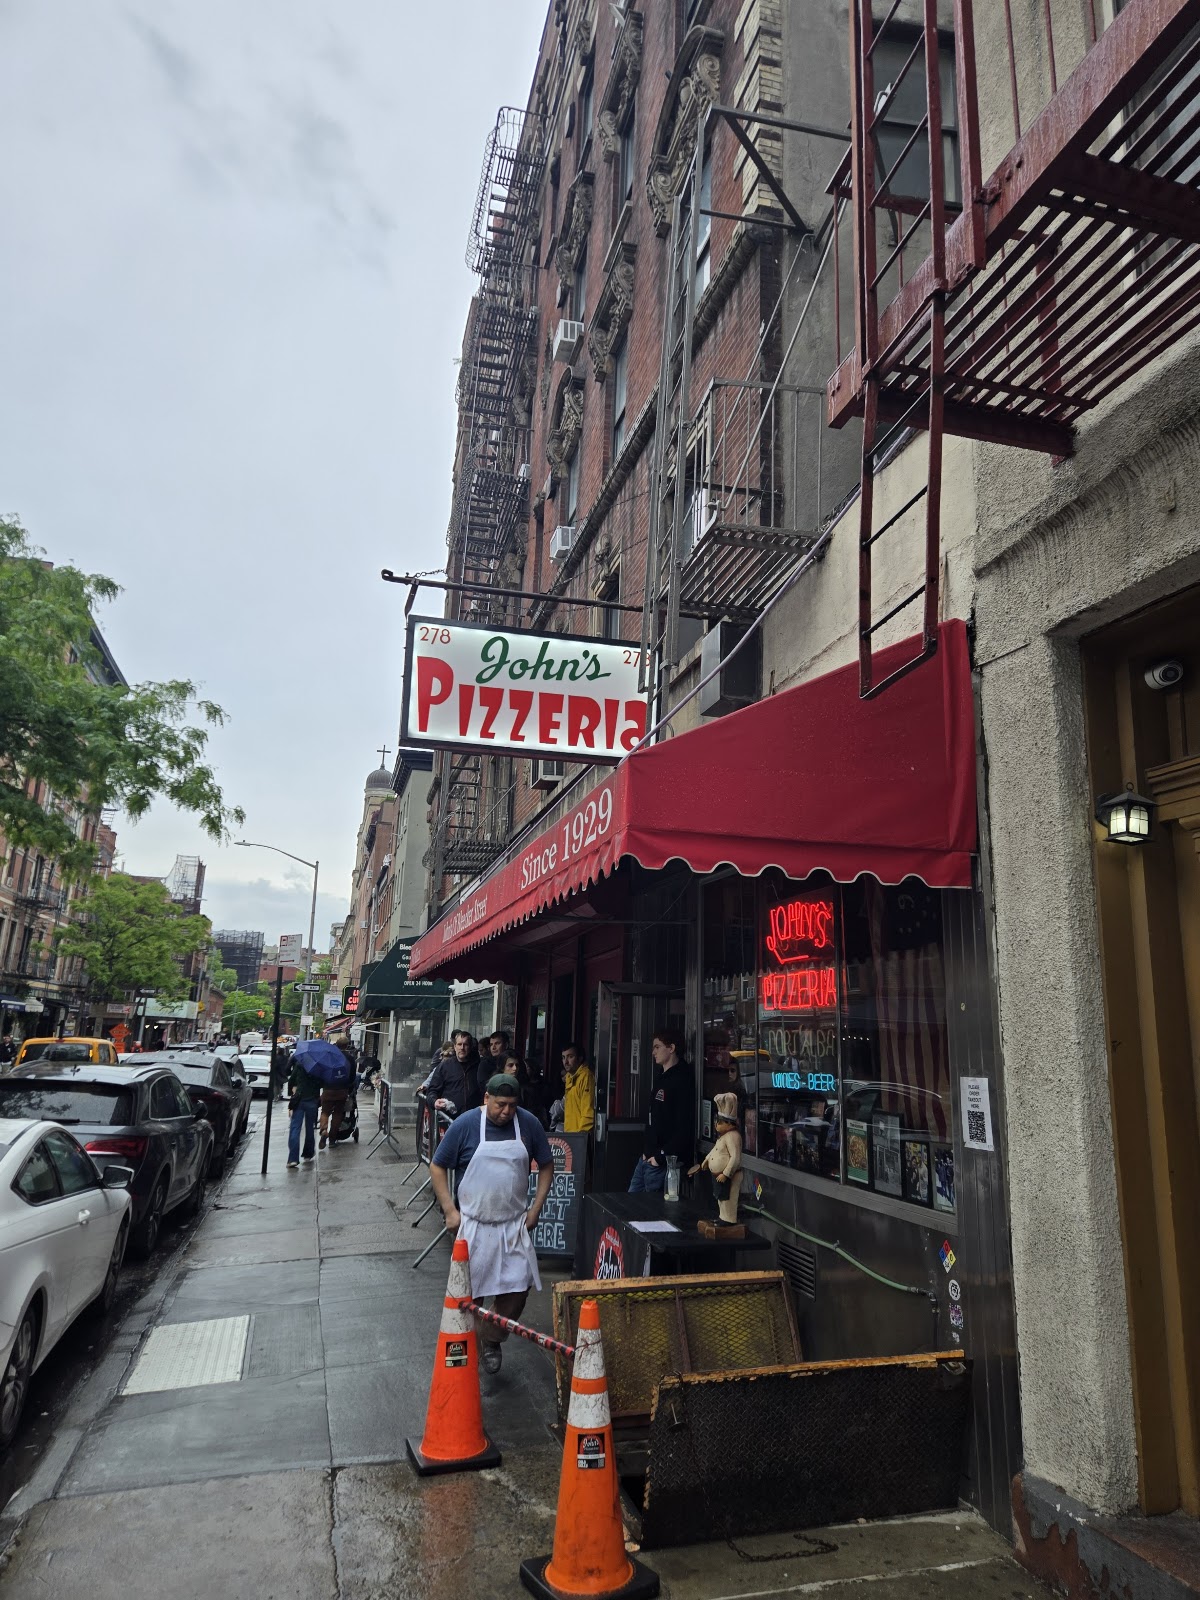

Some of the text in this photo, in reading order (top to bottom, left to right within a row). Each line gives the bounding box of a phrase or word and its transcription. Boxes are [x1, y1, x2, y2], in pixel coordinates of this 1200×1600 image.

[419, 626, 451, 645] 278
[475, 635, 612, 684] John's
[520, 787, 613, 891] Since 1929
[766, 901, 831, 951] JOHN'S
[763, 968, 836, 1011] PIZZERIA
[807, 1073, 836, 1092] BEER
[532, 1222, 566, 1249] ERE
